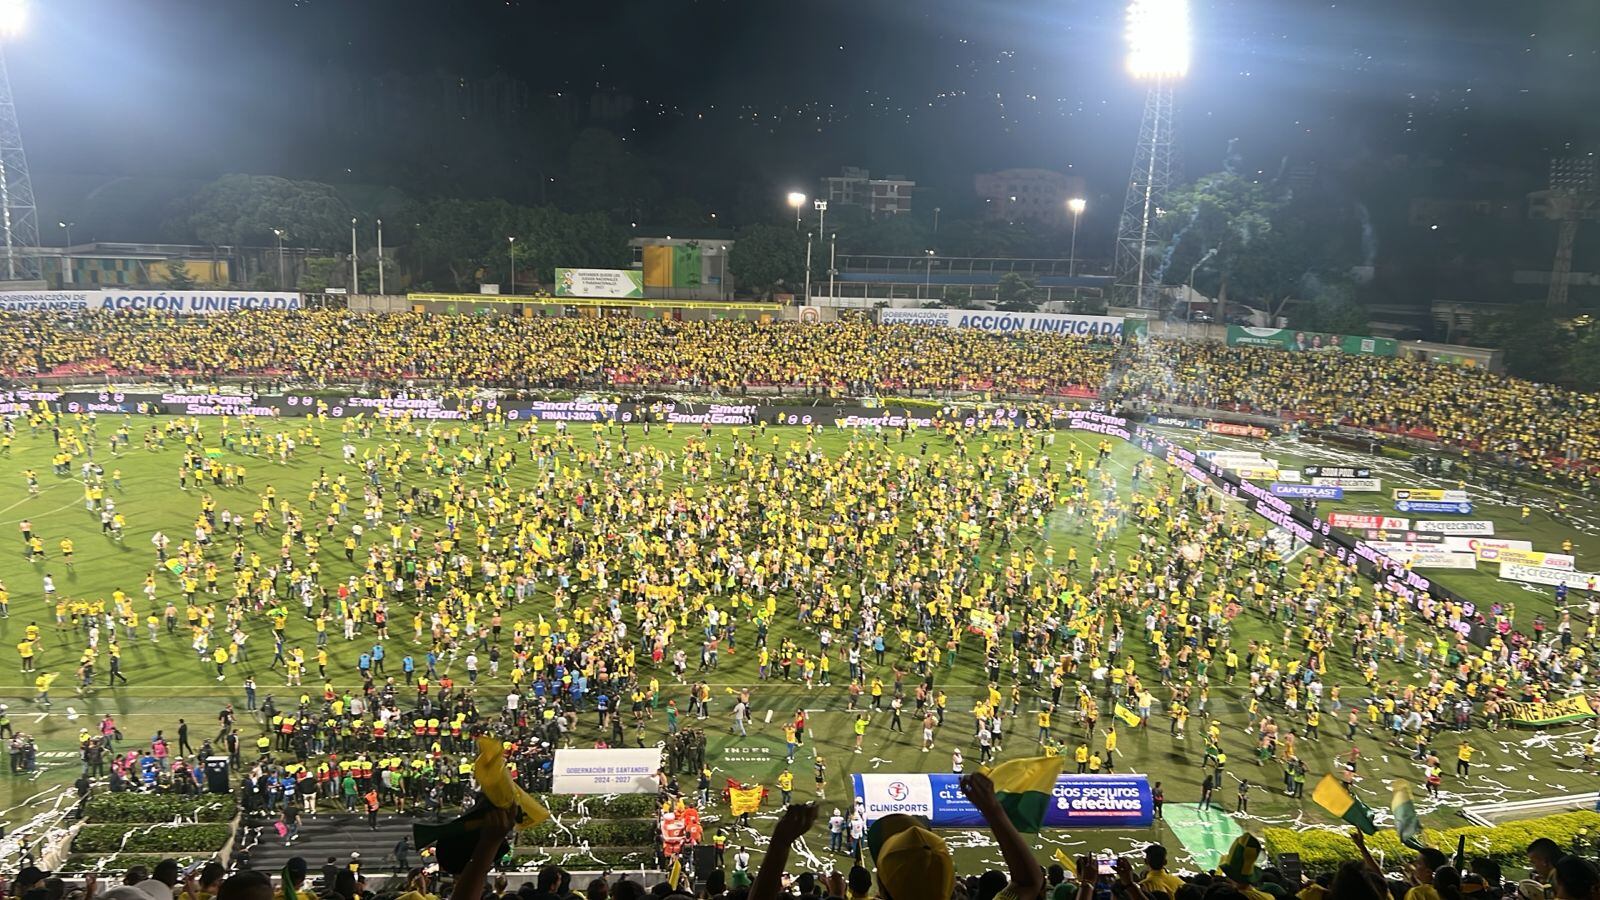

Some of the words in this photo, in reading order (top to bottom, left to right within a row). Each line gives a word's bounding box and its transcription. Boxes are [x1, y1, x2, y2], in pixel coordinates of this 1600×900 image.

[102, 292, 184, 311] ACCIÓN
[190, 296, 300, 311] UNIFICADA
[958, 313, 1025, 331] ACCIÓN
[1029, 318, 1124, 336] UNIFICADA
[161, 393, 253, 405] SmartGame
[532, 401, 619, 412] SmartGame
[1157, 417, 1186, 428] BetPlay
[1255, 500, 1314, 543] SmartGame
[1436, 521, 1486, 532] crezcamos
[566, 766, 606, 774] GOBERNACIÓN
[615, 766, 649, 774] SANTANDER
[1082, 787, 1140, 800] seguros
[870, 803, 928, 812] CLINISPORTS
[1057, 797, 1070, 810] &
[1071, 797, 1142, 810] efectivos
